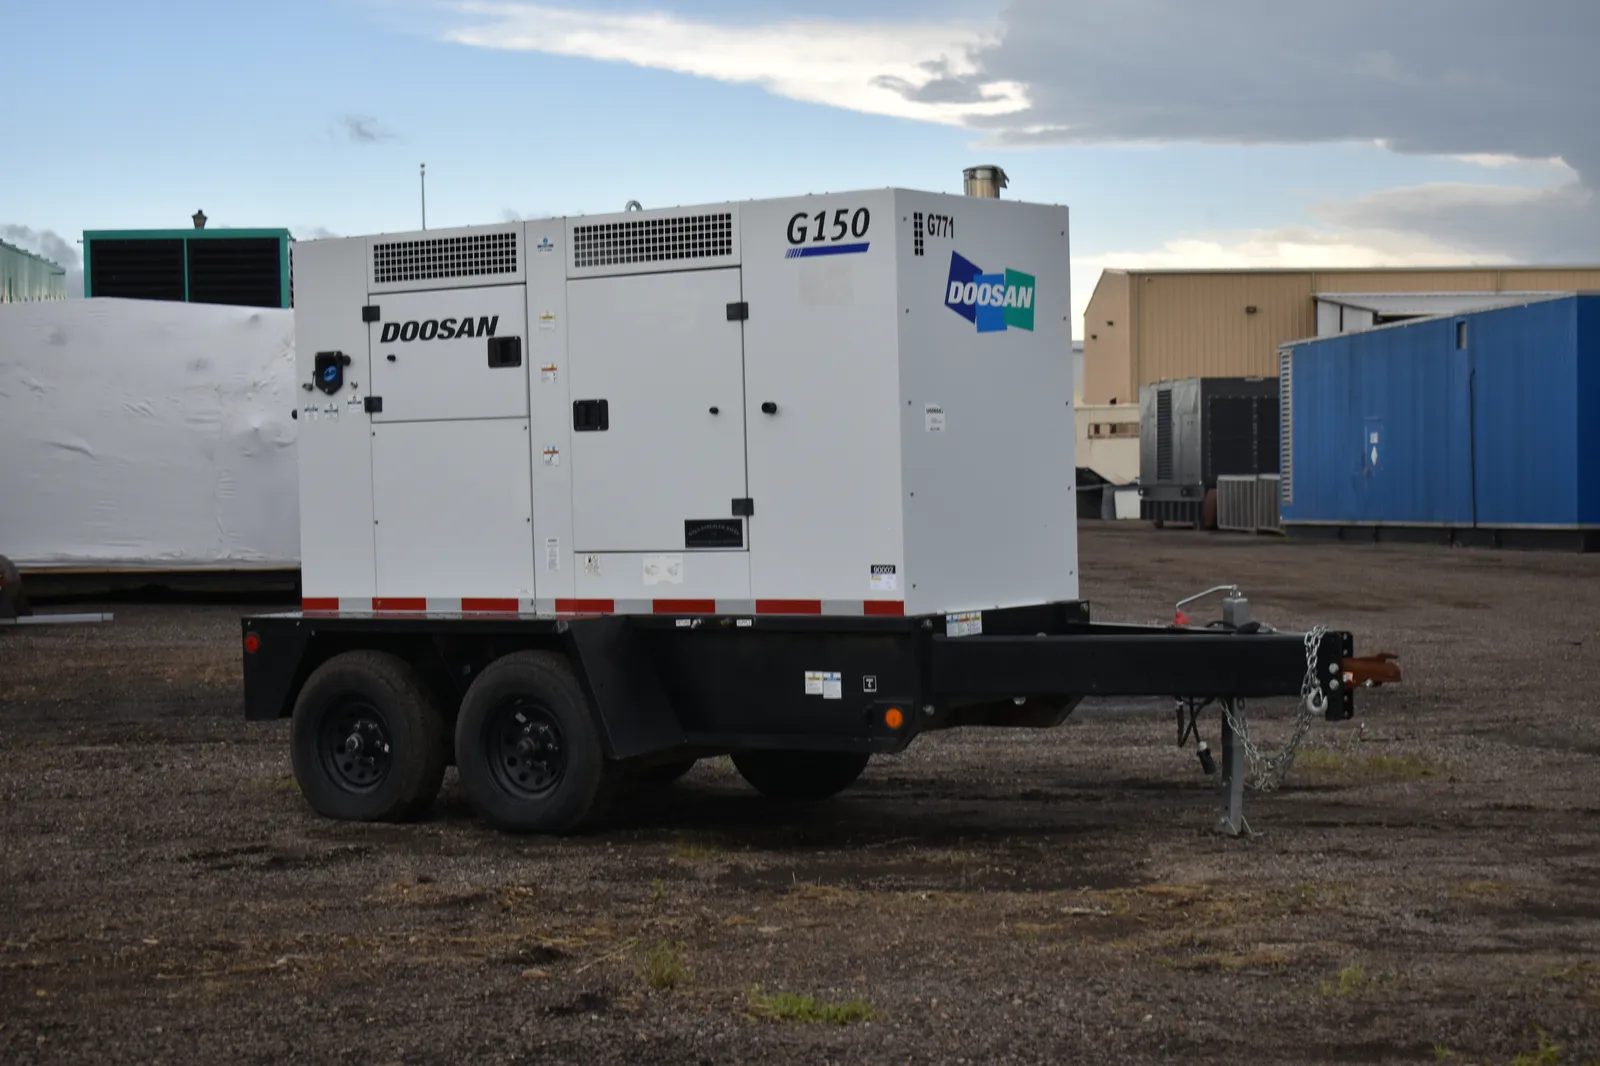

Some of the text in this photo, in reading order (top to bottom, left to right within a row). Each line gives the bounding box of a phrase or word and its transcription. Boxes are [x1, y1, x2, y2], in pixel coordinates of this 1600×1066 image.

[786, 207, 870, 245] G150
[927, 213, 954, 239] G771
[948, 280, 1033, 309] DOOSAN
[380, 315, 499, 343] DOOSAN
